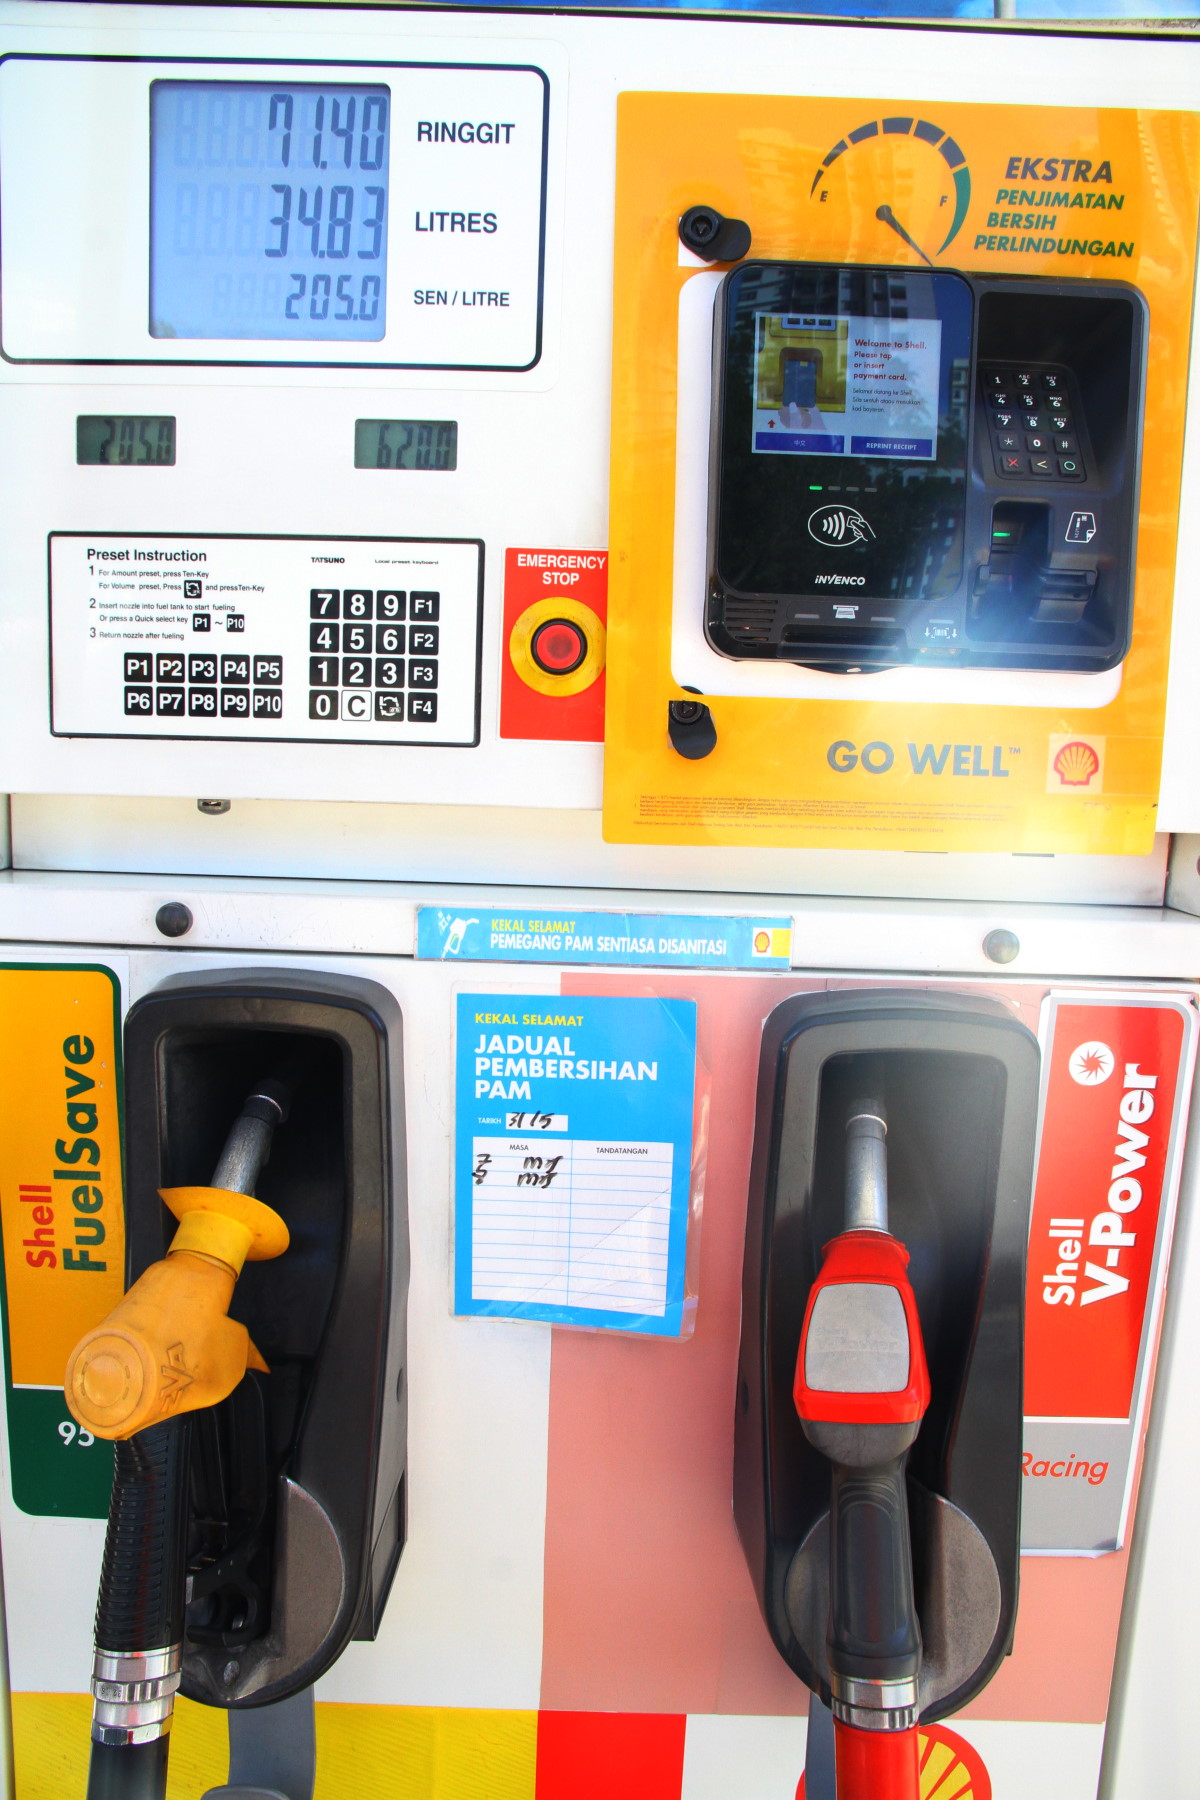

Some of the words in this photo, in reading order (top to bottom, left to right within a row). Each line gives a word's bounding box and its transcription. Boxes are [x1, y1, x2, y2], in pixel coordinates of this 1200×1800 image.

[269, 94, 387, 170] 71.40
[418, 122, 515, 144] RINGGIT
[1005, 157, 1113, 183] EKSTRA
[820, 191, 828, 202] E
[939, 196, 948, 206] F
[996, 189, 1125, 210] PENJIMATAN
[265, 185, 385, 259] 34.83
[416, 212, 498, 233] LITRES
[987, 212, 1056, 230] BERSIH
[974, 235, 1134, 257] PERLINDUNGAN
[285, 274, 381, 321] 205.0
[414, 290, 447, 305] SEN
[463, 292, 510, 306] LITRE
[855, 339, 891, 348] Welcome
[1033, 439, 1041, 447] 0
[88, 549, 130, 560] Preset
[134, 549, 207, 561] Instruction
[518, 554, 606, 569] EMERGENCY
[89, 565, 94, 575] 1
[99, 569, 109, 577] For
[112, 569, 137, 577] Amount
[139, 570, 161, 578] preset,
[183, 571, 209, 579] Ten-Key
[543, 572, 579, 585] STOP
[139, 583, 161, 591] preset,
[90, 598, 96, 608] 2
[212, 604, 235, 612] fueling
[318, 594, 332, 614] 7
[351, 594, 365, 616] 8
[384, 595, 398, 616] 9
[415, 600, 432, 614] F1
[135, 615, 153, 623] Quick
[177, 616, 188, 624] key
[195, 618, 208, 628] P1
[227, 619, 244, 628] P10
[90, 628, 96, 638] 3
[162, 632, 184, 640] fueling
[317, 628, 332, 648] 4
[350, 629, 365, 650] 5
[383, 629, 398, 650] 6
[414, 633, 434, 647] F2
[128, 659, 147, 676] P1
[159, 660, 182, 676] P2
[192, 660, 214, 677] P3
[224, 661, 247, 677] P4
[257, 662, 280, 678] P5
[318, 661, 328, 682] 1
[350, 662, 364, 683] 2
[382, 663, 397, 684] 3
[414, 667, 433, 681] F3
[128, 693, 150, 709] P6
[159, 693, 182, 709] P7
[192, 694, 214, 710] P8
[224, 694, 247, 711] P9
[254, 695, 281, 712] P10
[316, 695, 330, 716] 0
[348, 695, 365, 717] C
[413, 701, 432, 715] F4
[827, 740, 894, 773] GO
[492, 919, 525, 932] KEKAL
[528, 920, 575, 934] SELAMAT
[490, 935, 561, 951] PEMEGANG
[565, 936, 594, 951] PAM
[597, 937, 655, 954] SENTIASA
[659, 939, 726, 955] DISANITASI
[475, 1013, 518, 1024] KEKAL
[523, 1015, 584, 1026] SELAMAT
[474, 1035, 575, 1056] JADUAL
[476, 1058, 658, 1080] PEMBERSIHAN
[475, 1080, 531, 1100] PAM
[54, 1034, 107, 1273] FuelSave
[597, 1147, 647, 1155] TANDATANGAN
[1081, 1062, 1158, 1307] V-Power
[20, 1184, 56, 1269] Shell
[1043, 1218, 1084, 1306] Shell
[57, 1421, 94, 1447] 95
